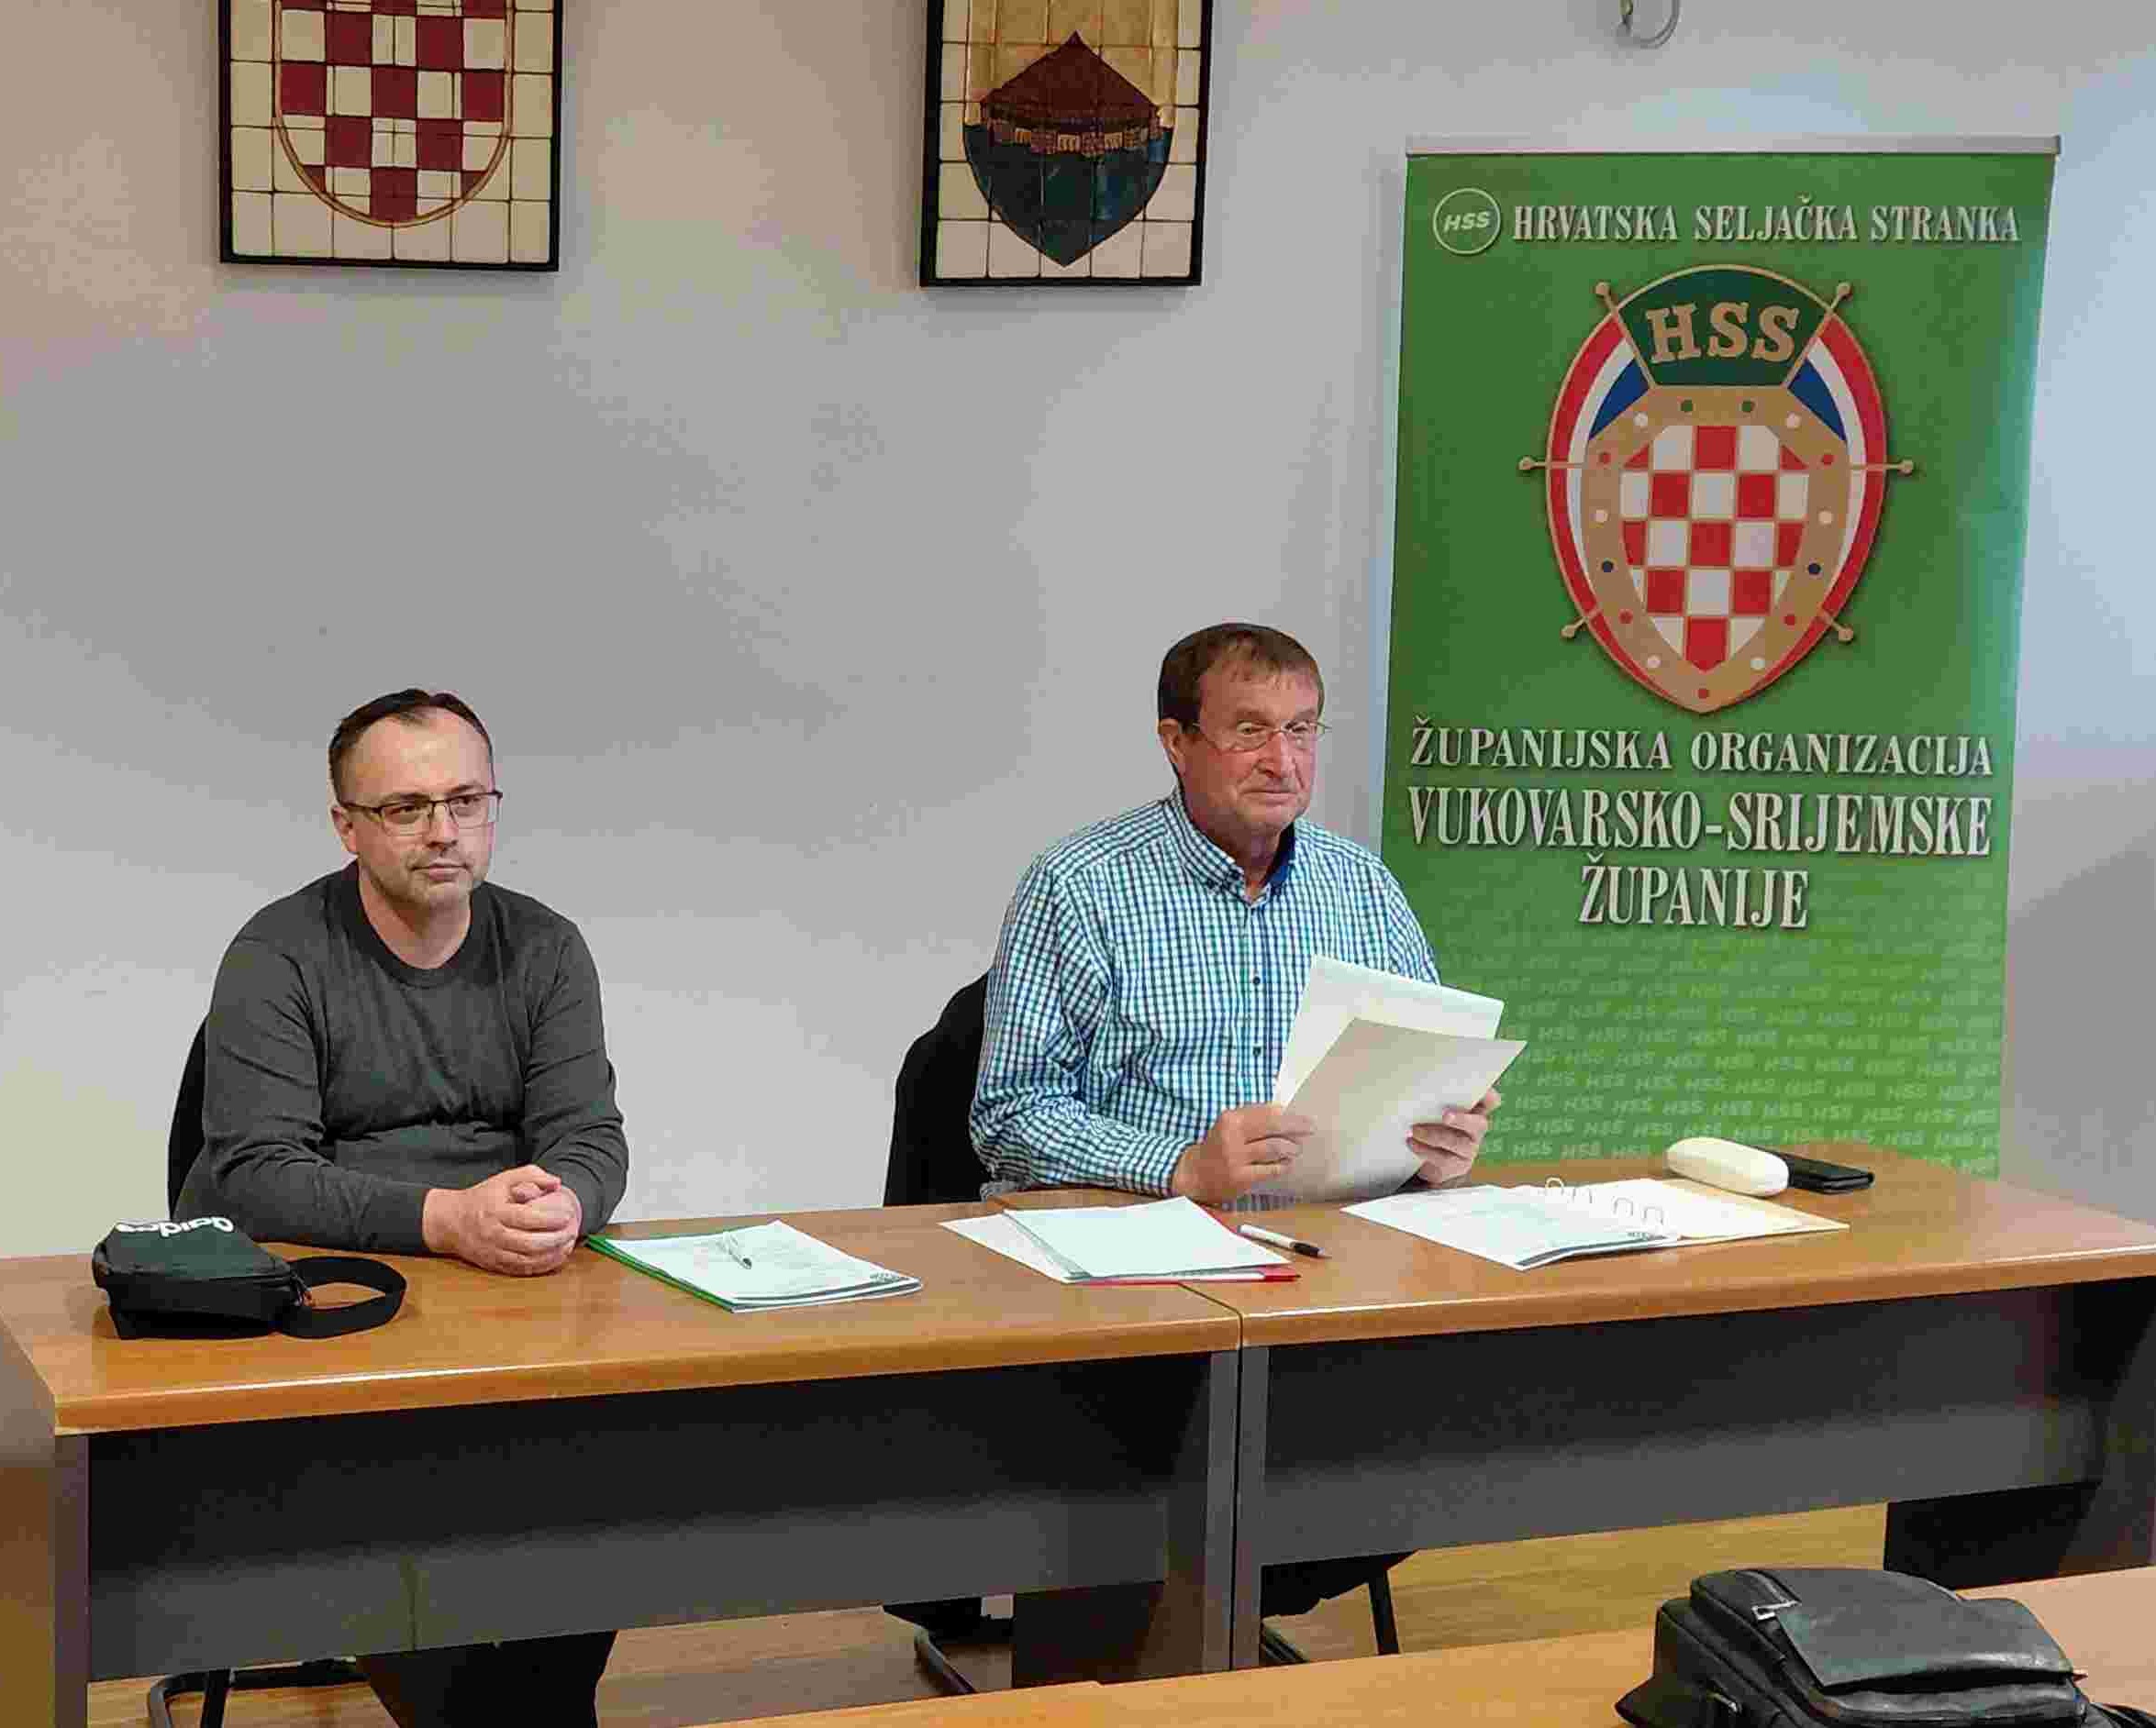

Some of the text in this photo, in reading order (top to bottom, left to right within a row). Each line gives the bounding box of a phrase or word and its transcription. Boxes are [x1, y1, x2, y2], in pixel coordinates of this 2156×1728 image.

[1443, 211, 1491, 231] HSS
[1513, 194, 2020, 242] HRVATSKA SELJAČKA STRANKA
[1645, 302, 1801, 363] HSS
[1411, 715, 1992, 776] ŽUPANIJSKA ORGANIZACIJA
[1409, 786, 1992, 855] VUKOVARSKO-SRIJEMSKE
[1578, 854, 1809, 929] ŽUPANIJE
